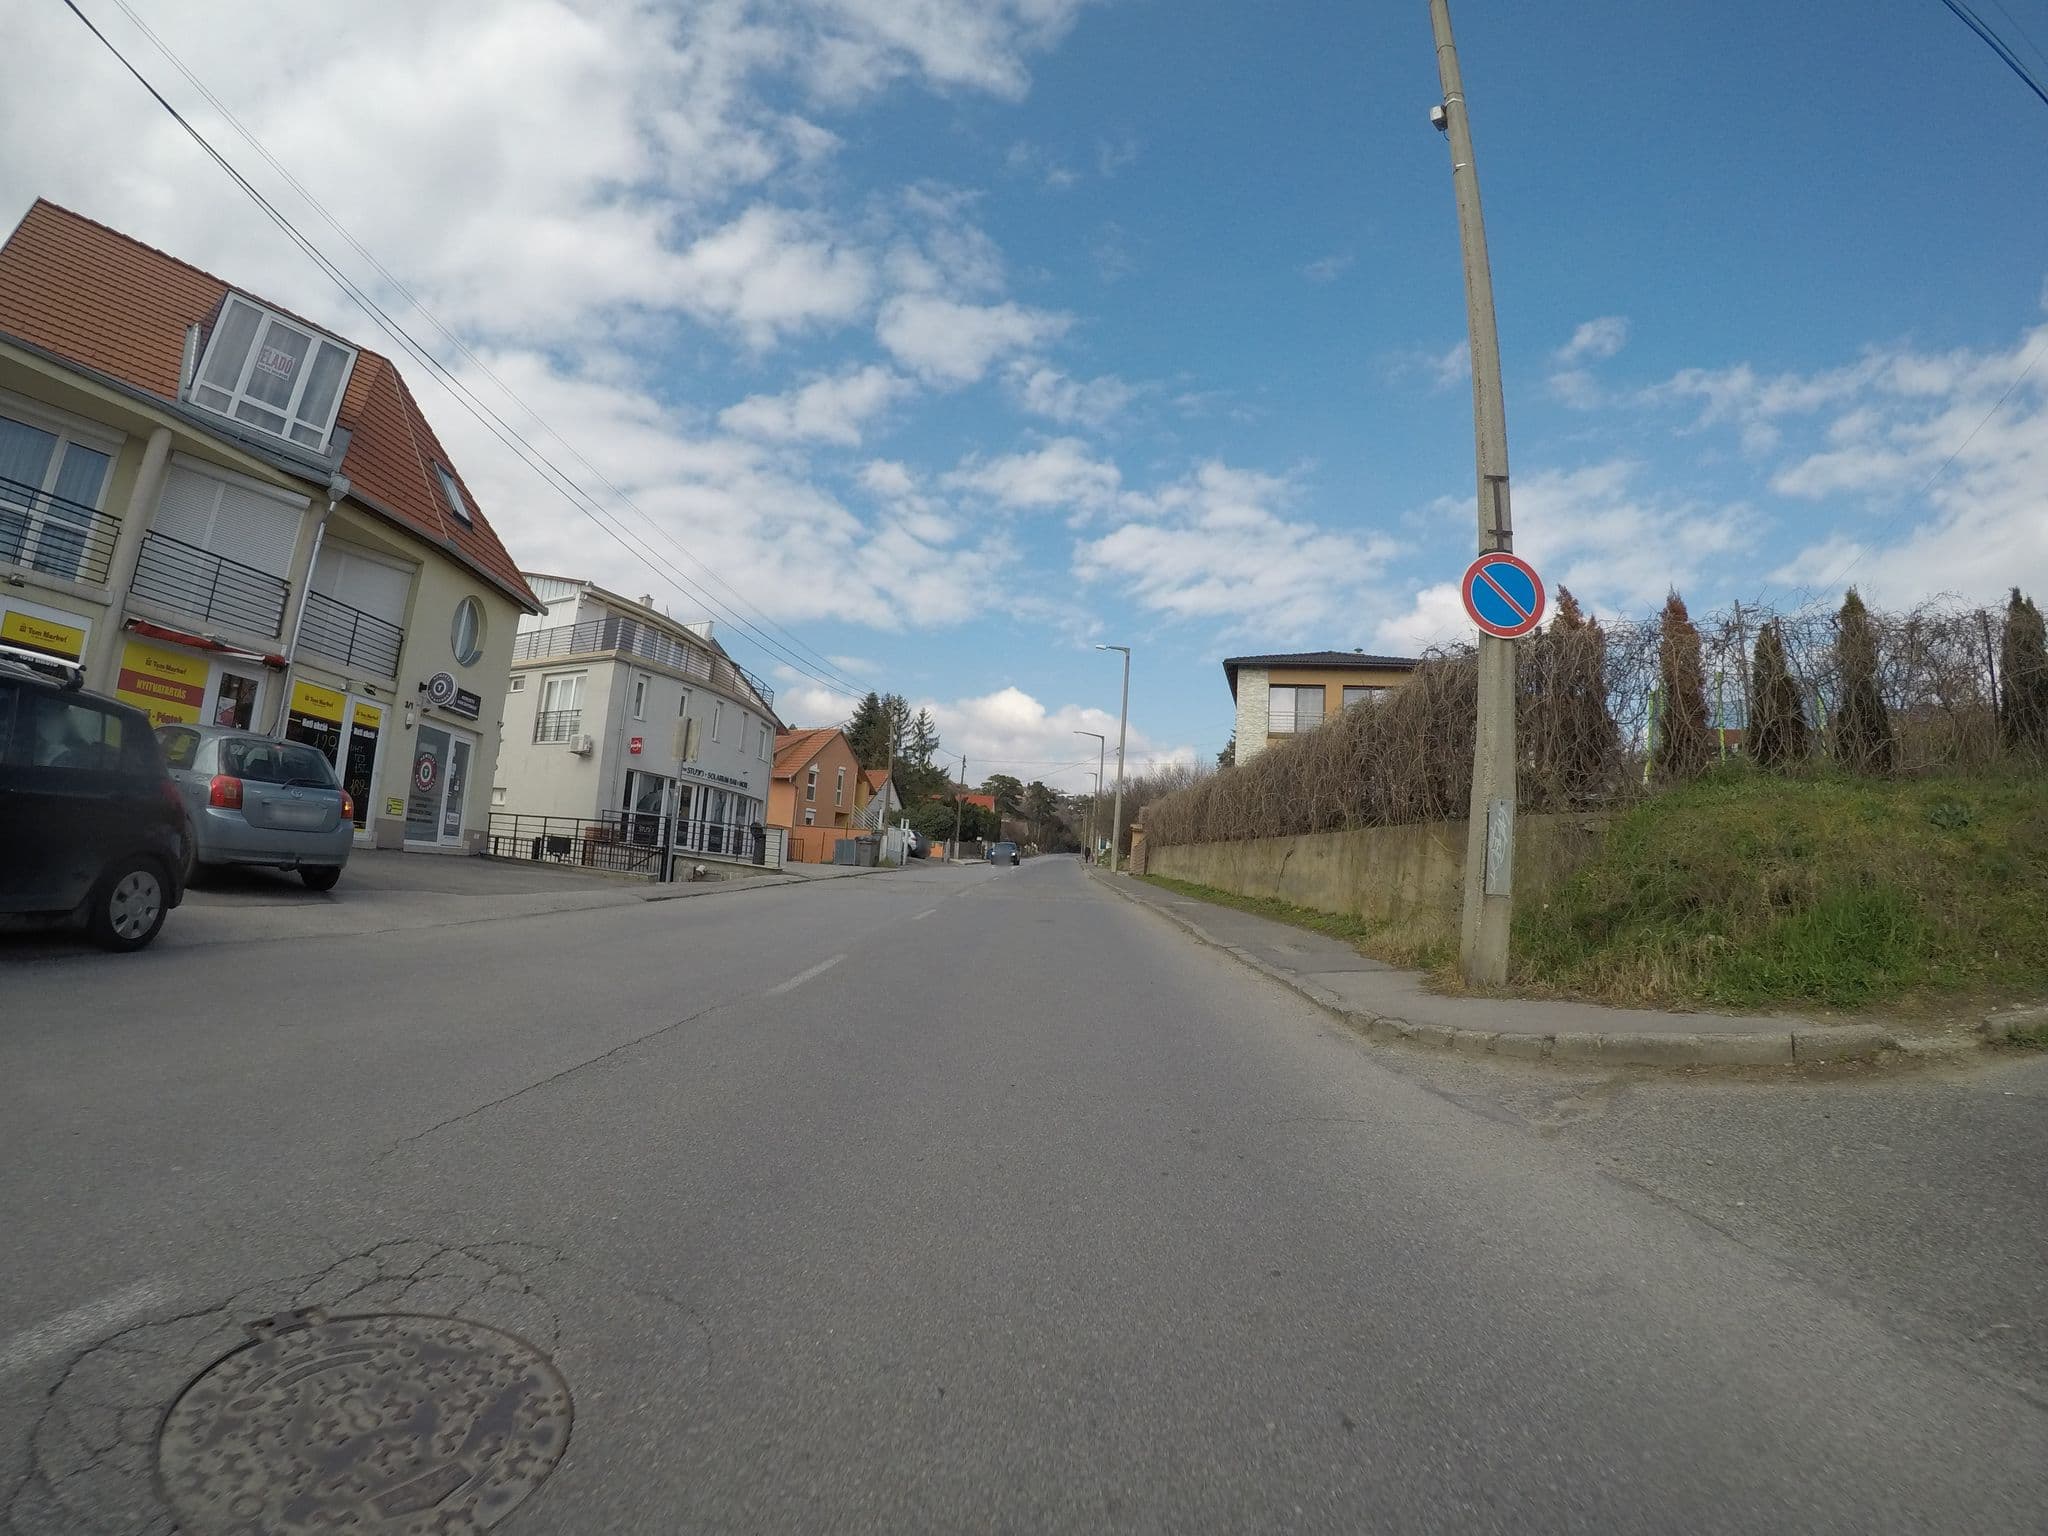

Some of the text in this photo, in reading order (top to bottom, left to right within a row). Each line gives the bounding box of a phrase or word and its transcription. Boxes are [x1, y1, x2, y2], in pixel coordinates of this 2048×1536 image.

[28, 626, 42, 637] Tom
[43, 630, 68, 643] Market
[153, 660, 165, 669] Tom
[166, 664, 187, 675] Market
